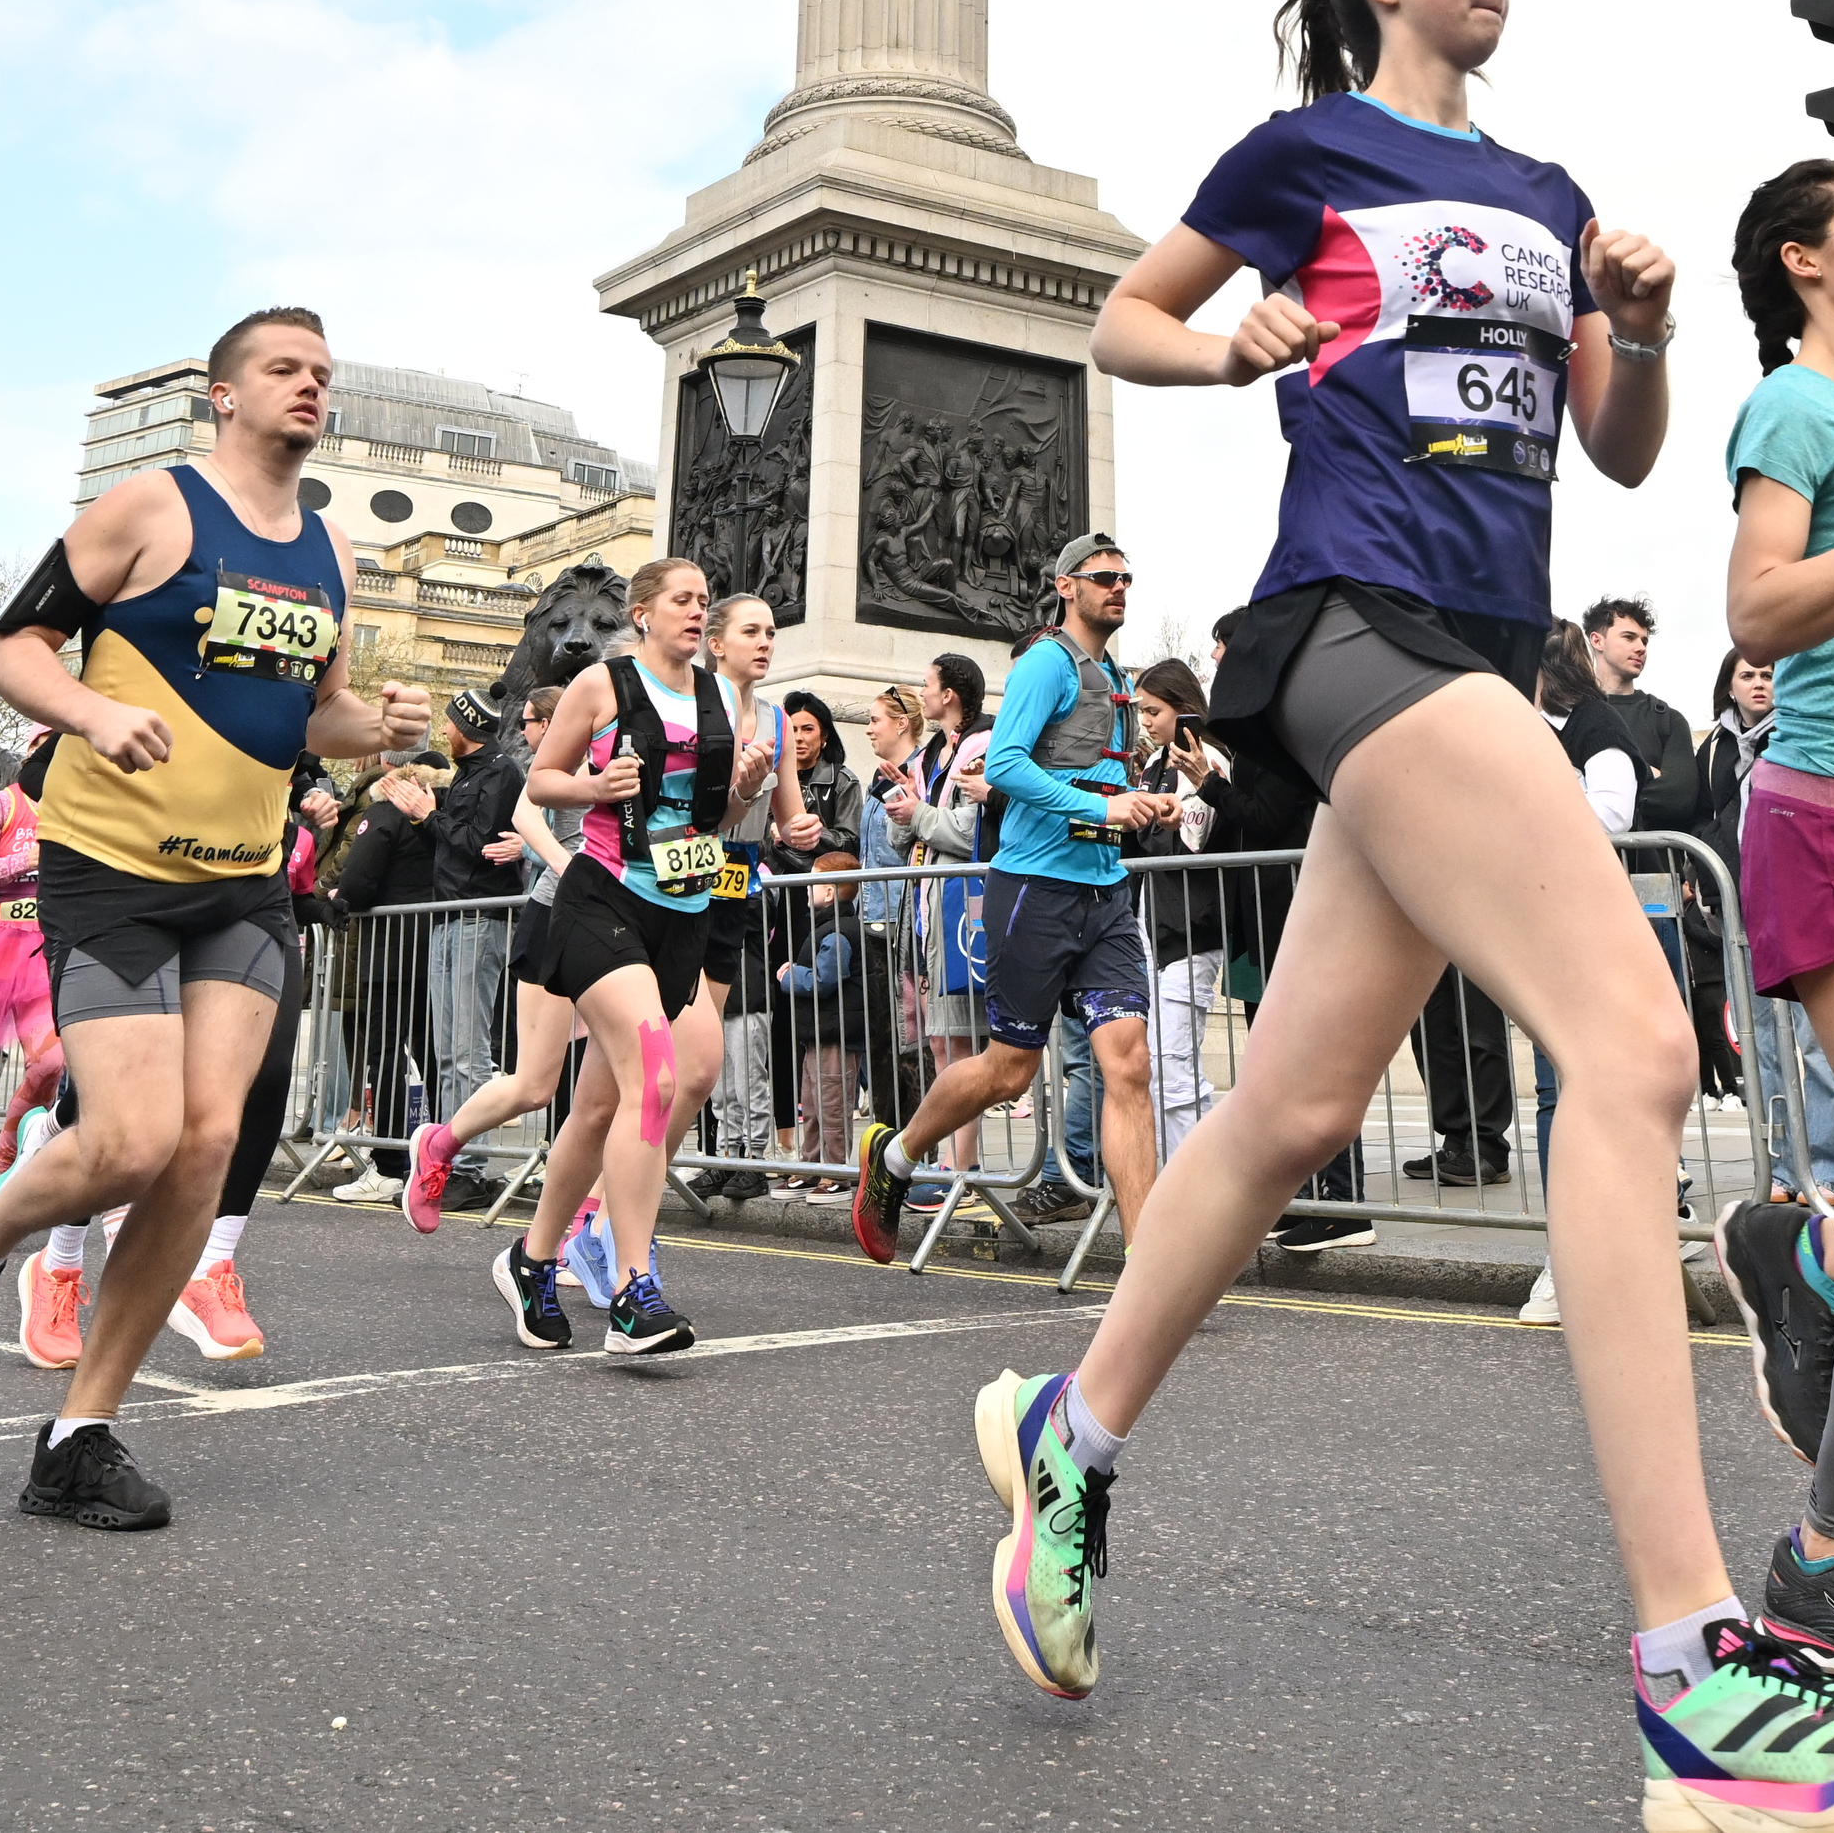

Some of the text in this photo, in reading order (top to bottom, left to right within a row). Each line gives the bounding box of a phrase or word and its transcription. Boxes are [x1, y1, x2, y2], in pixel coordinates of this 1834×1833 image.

[1501, 244, 1565, 280] CANCE
[1505, 288, 1531, 312] UK
[1480, 326, 1528, 348] HOLLY
[1456, 362, 1537, 422] 645
[247, 578, 308, 601] SCAMPTON
[236, 601, 318, 648] 7343
[666, 842, 716, 873] 8123
[10, 901, 38, 919] 82
